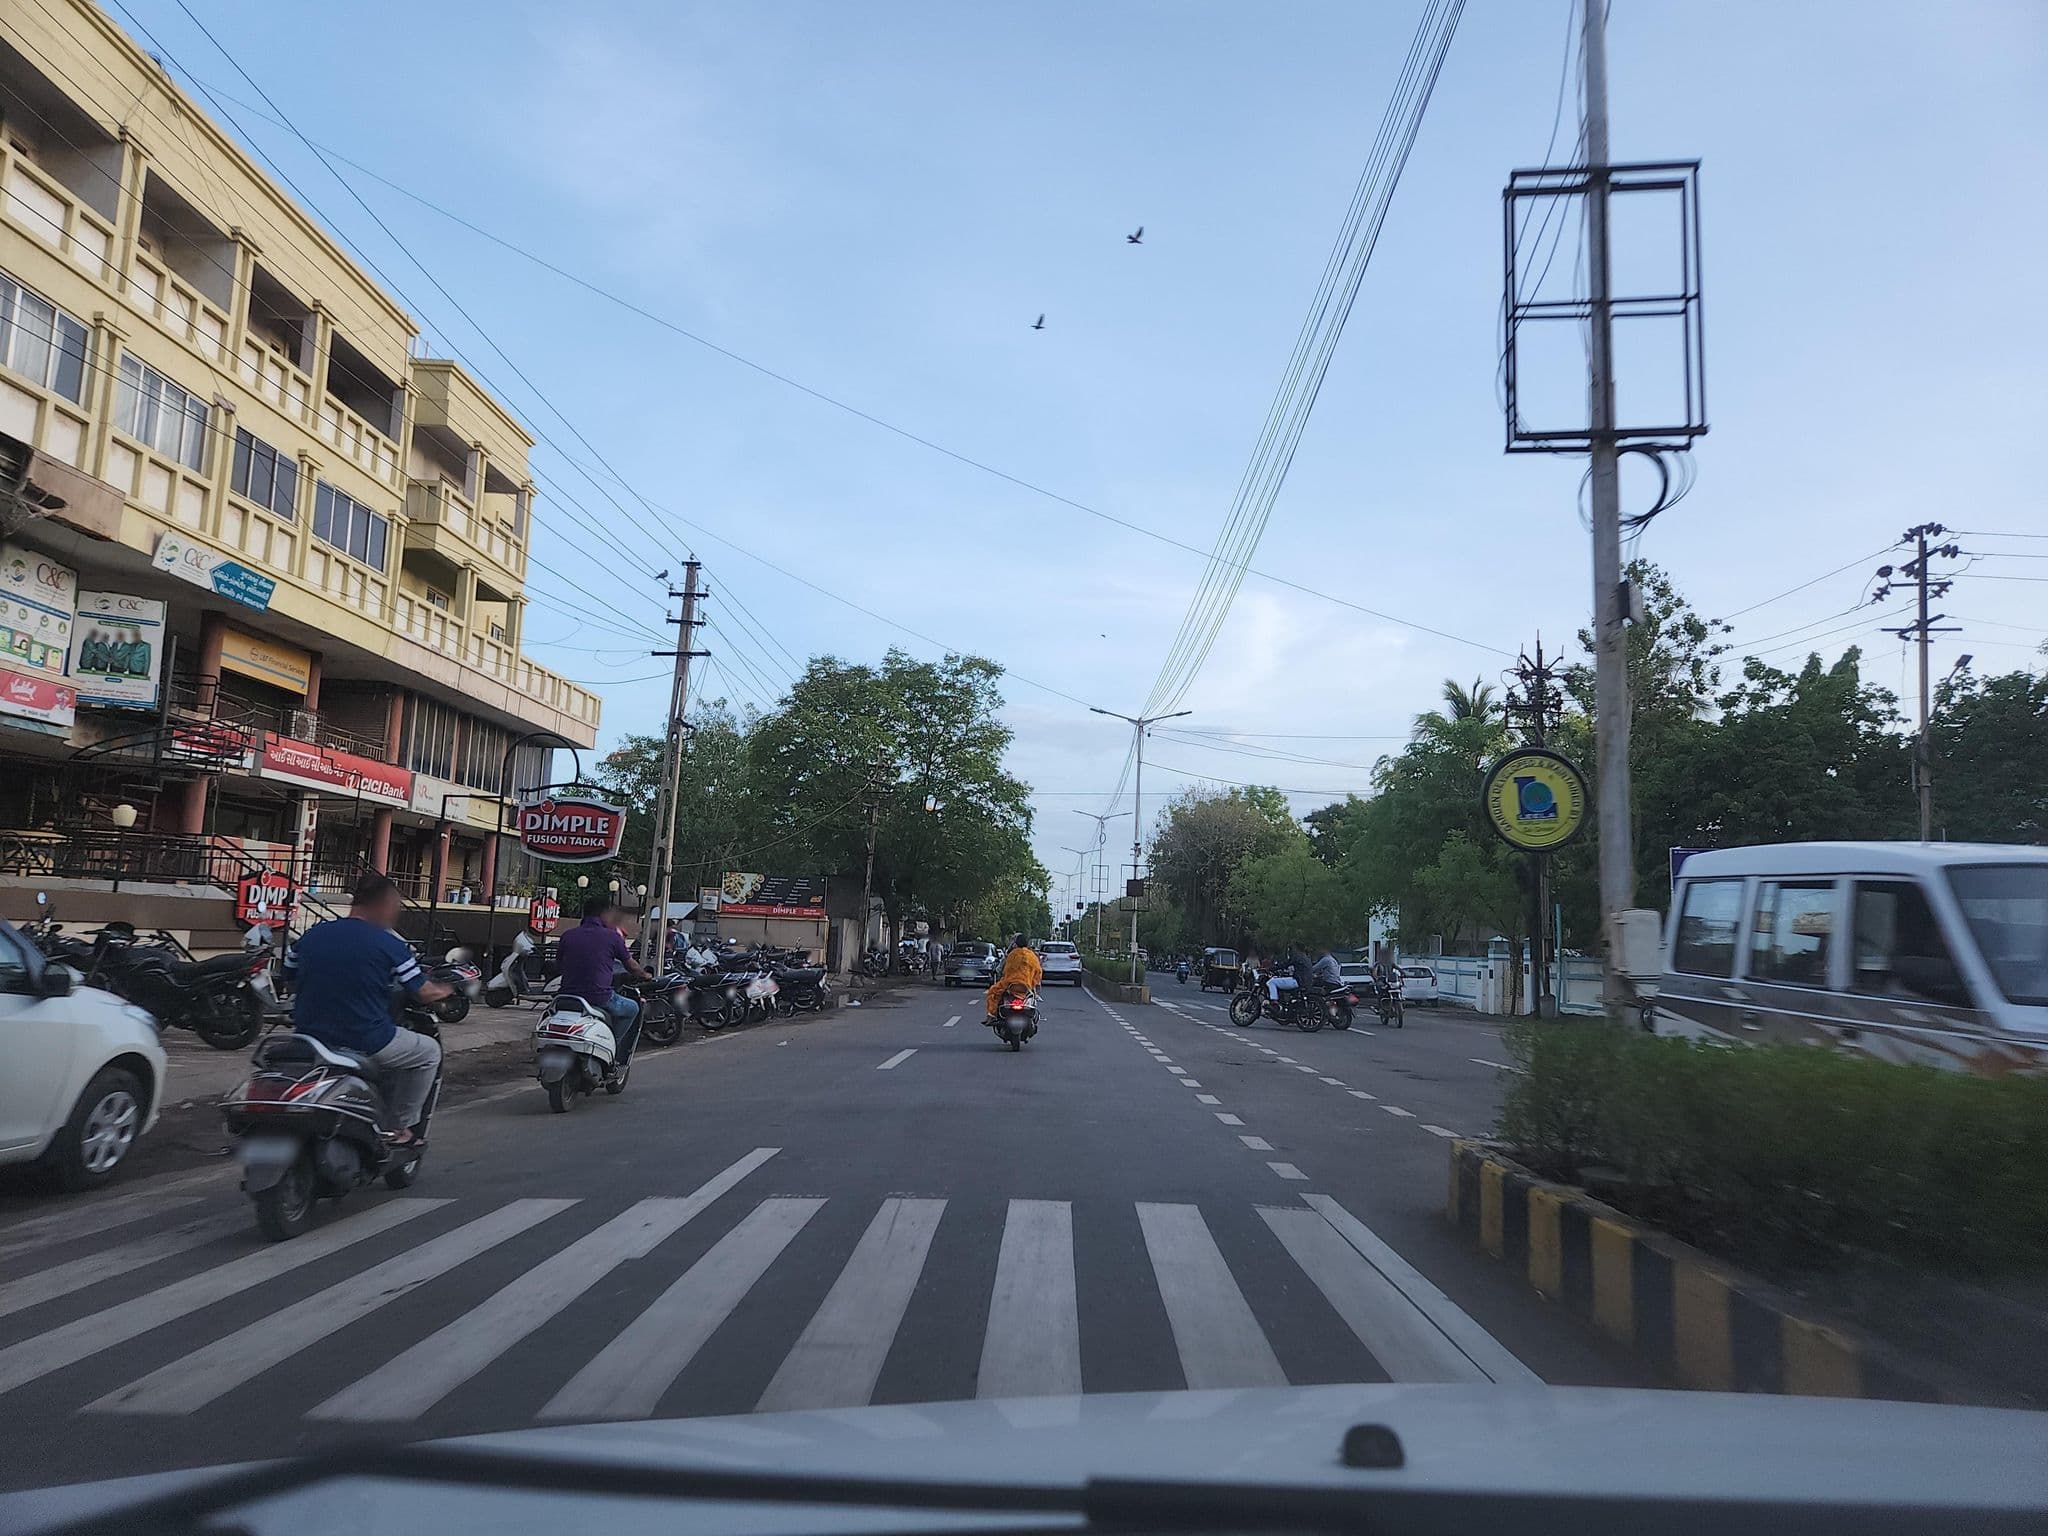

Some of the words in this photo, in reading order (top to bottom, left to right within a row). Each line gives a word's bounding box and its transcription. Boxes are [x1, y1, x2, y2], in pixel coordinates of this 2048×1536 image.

[356, 774, 384, 794] ICICI
[383, 782, 405, 799] Bank
[525, 813, 609, 835] DIMPLE
[526, 834, 567, 846] FUSION
[569, 836, 606, 847] TADKA
[248, 884, 302, 907] DIMPE
[772, 906, 797, 915] DIMPLE
